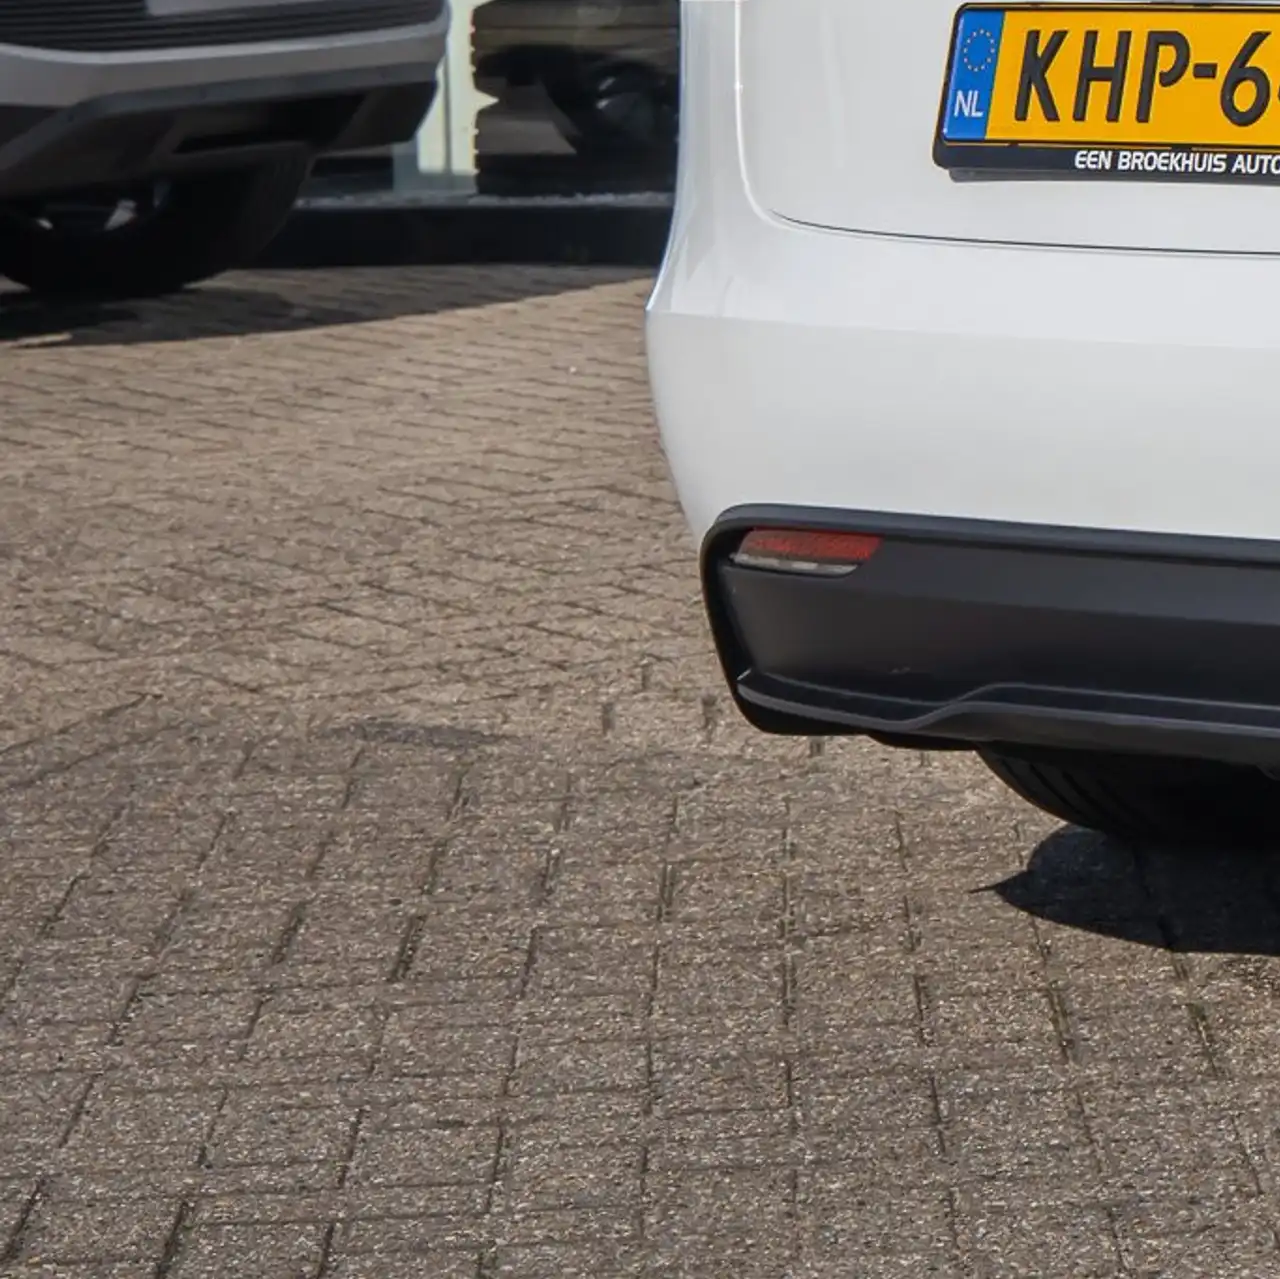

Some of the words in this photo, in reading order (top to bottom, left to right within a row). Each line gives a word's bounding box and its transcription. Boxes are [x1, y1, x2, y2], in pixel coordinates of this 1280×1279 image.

[954, 90, 984, 118] NL
[1074, 150, 1113, 170] EEN
[1117, 152, 1228, 173] BROEKHUIS
